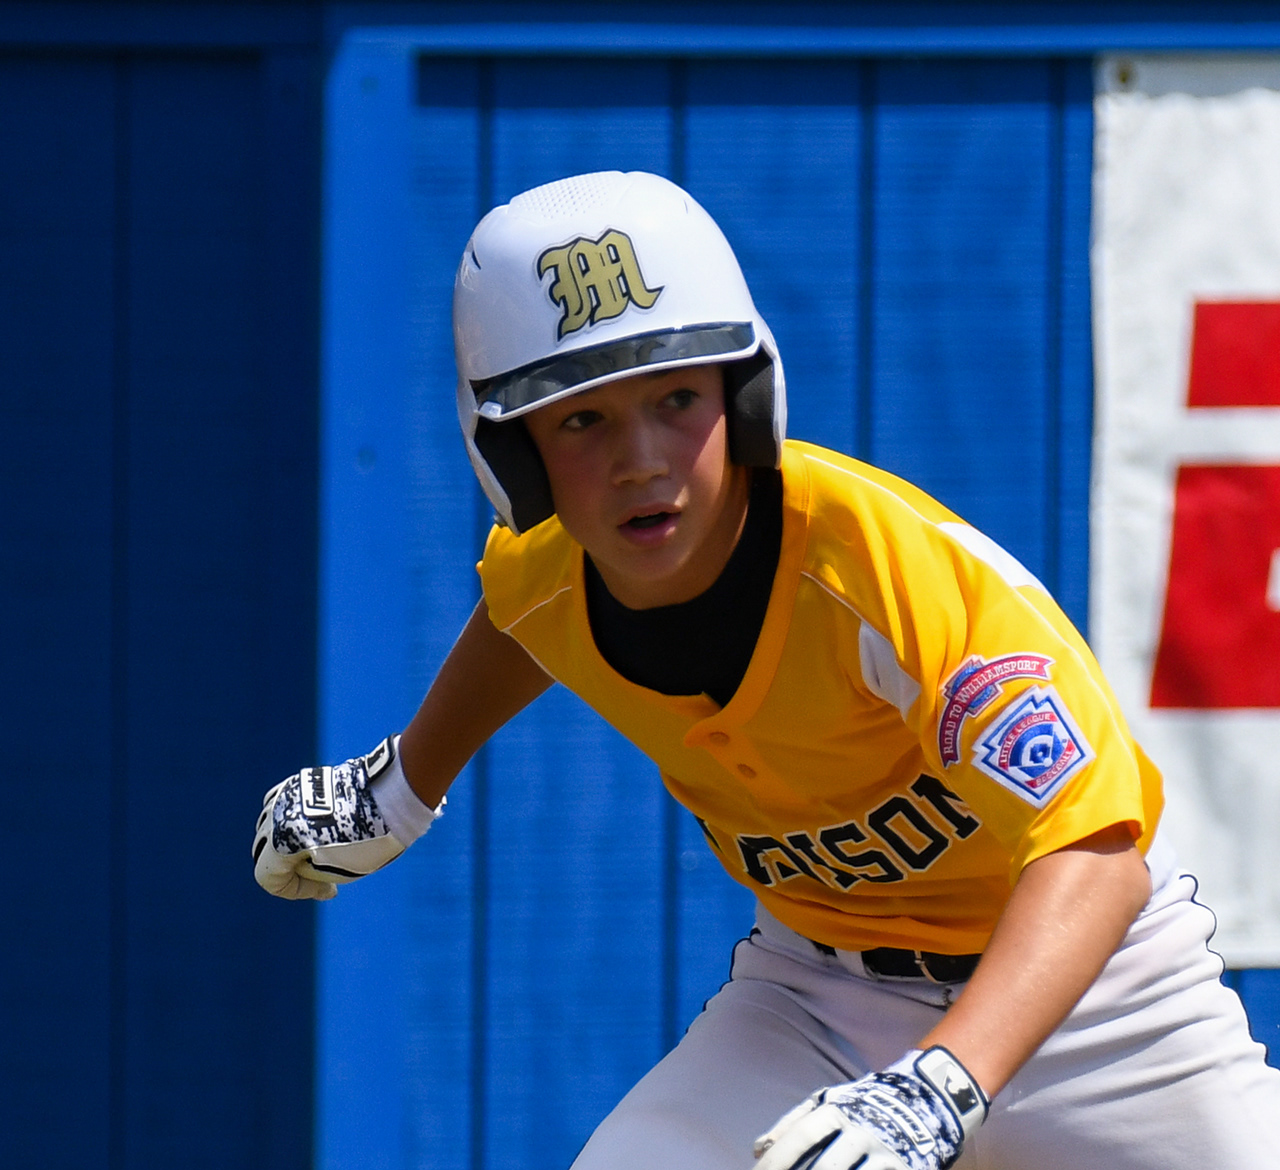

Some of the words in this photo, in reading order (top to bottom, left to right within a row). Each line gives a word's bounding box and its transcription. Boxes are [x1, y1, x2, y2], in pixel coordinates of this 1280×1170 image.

[537, 228, 665, 342] M
[955, 660, 1040, 704] WILLIAMSPORT
[949, 703, 963, 719] TO
[943, 720, 957, 755] ROAD
[1000, 733, 1016, 763] LITTLE
[1015, 713, 1051, 733] LEAGUE
